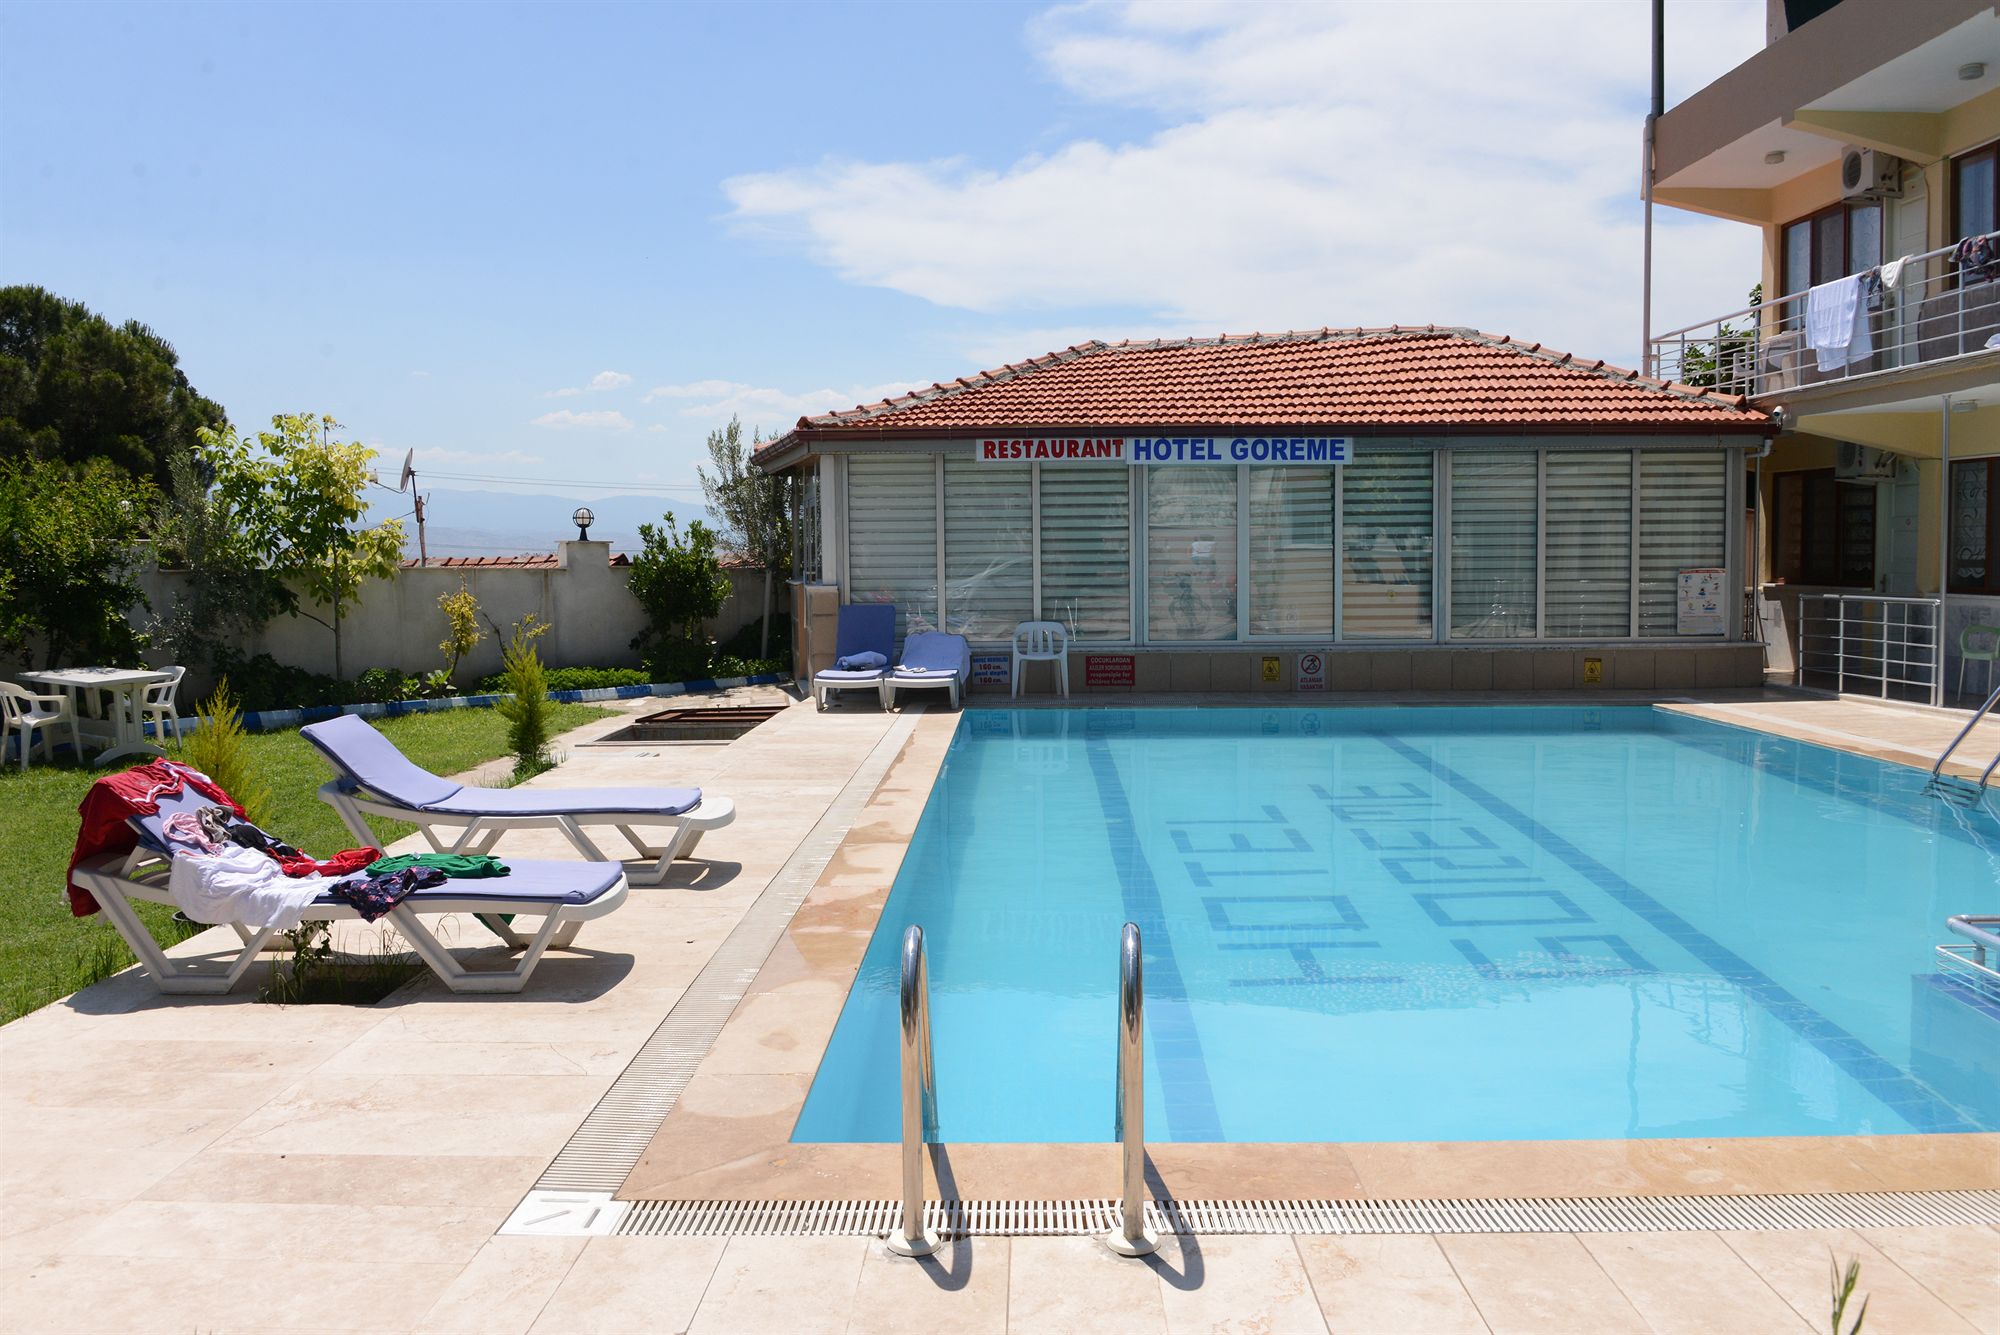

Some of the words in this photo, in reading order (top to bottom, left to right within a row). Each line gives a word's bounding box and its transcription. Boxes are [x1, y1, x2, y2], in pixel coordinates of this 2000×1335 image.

[983, 438, 1124, 459] RESTAURANT
[1133, 438, 1222, 461] HOTEL
[1230, 438, 1345, 461] GOREME
[1166, 805, 1403, 987] HOTEL
